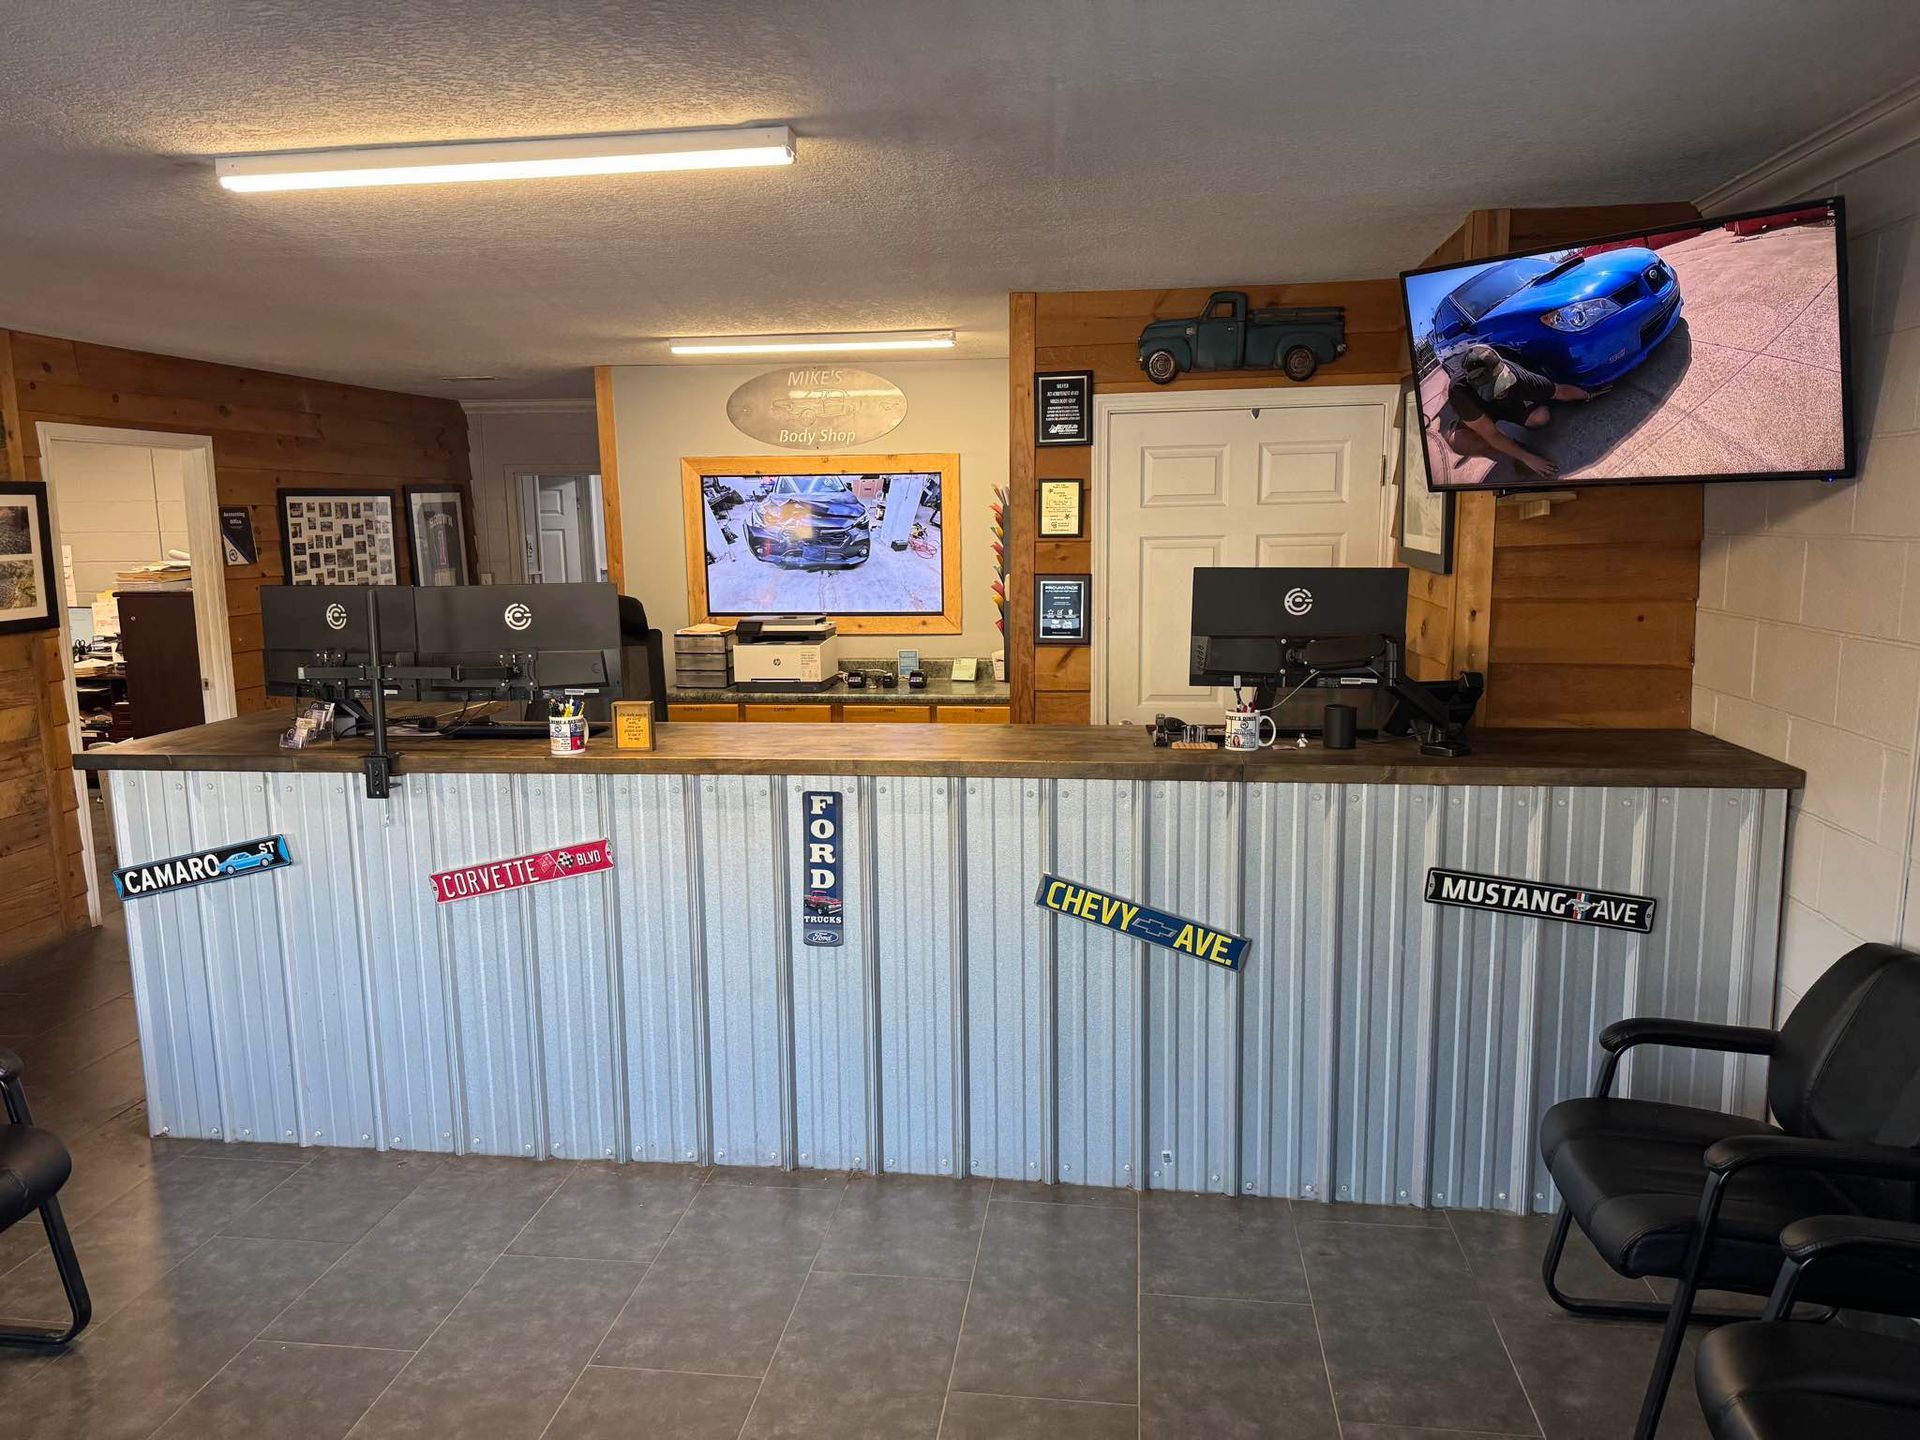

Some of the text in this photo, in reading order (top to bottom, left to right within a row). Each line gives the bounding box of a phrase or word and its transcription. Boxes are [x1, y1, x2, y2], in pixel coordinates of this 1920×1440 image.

[787, 370, 844, 386] MIKE'S
[779, 429, 856, 445] Body Shop
[809, 796, 836, 889] FORD
[124, 841, 275, 894] CAMARO ST
[441, 849, 601, 898] CORVETTE BLVD
[803, 916, 842, 924] TRUCKS
[1046, 881, 1233, 966] CHEVY AVE.
[1441, 877, 1639, 924] MUSTANG AVE
[812, 932, 834, 942] Ford
